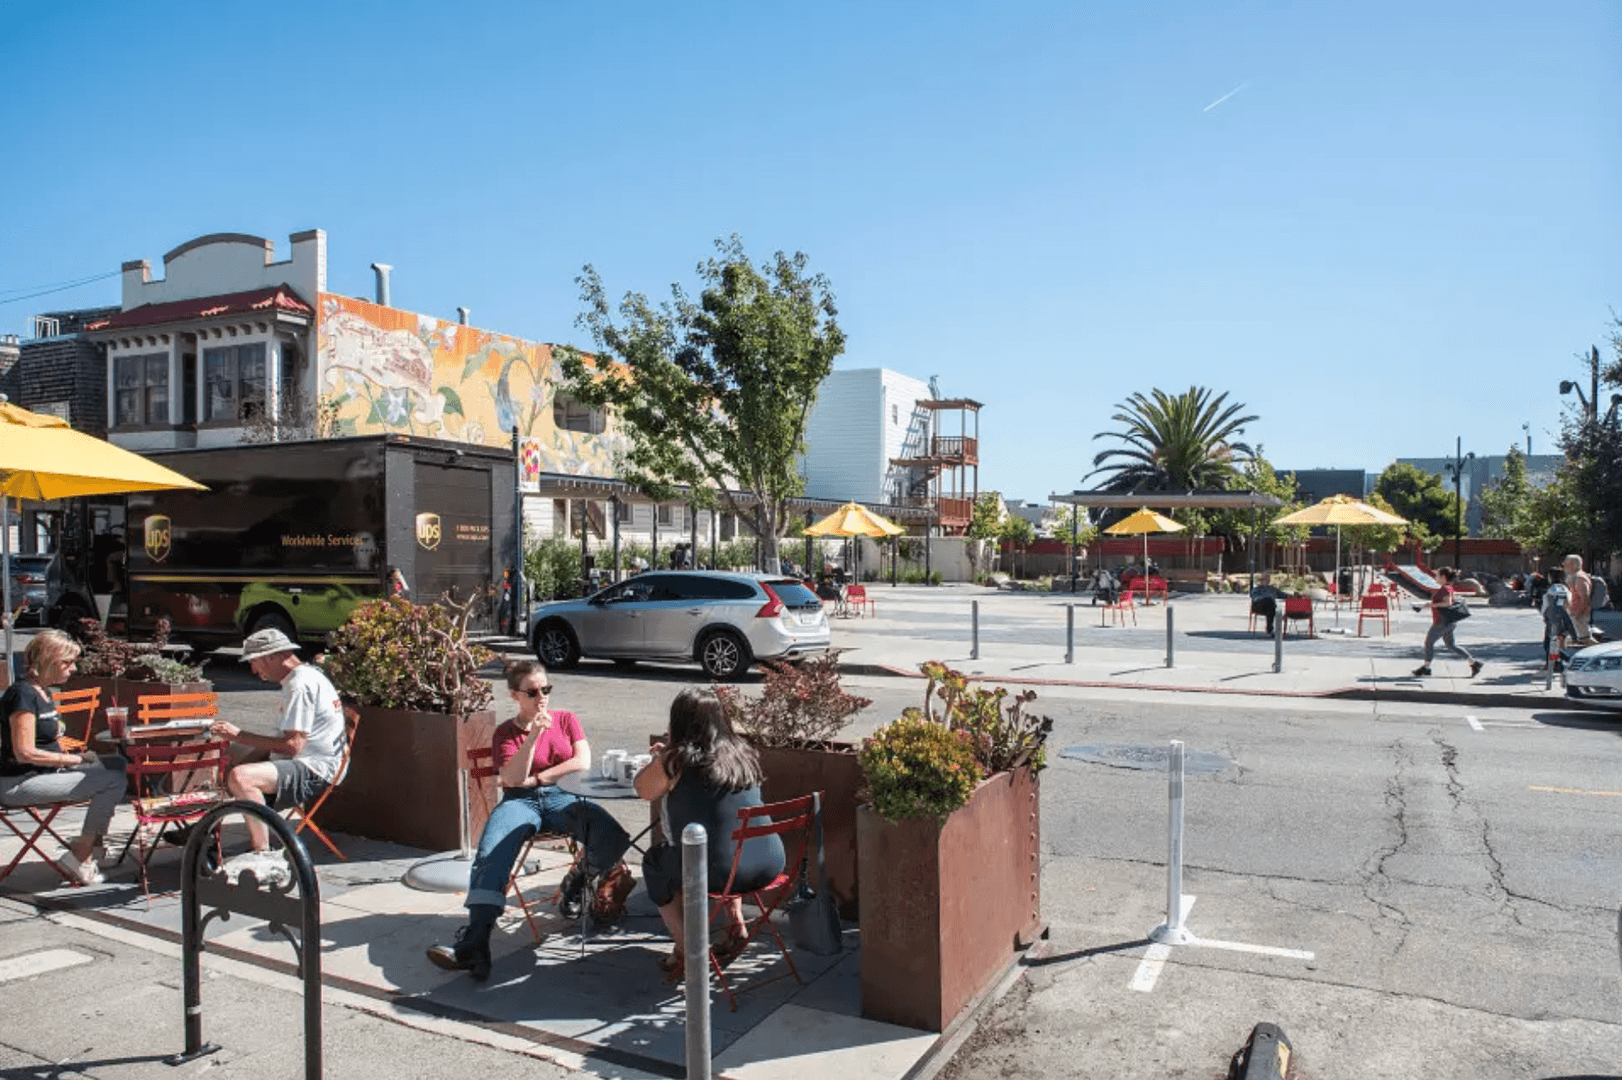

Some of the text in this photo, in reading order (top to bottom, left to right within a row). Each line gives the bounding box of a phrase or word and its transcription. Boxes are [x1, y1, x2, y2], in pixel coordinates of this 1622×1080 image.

[147, 530, 170, 555] ups
[281, 534, 364, 546] Worldwide Services
[419, 524, 440, 543] ups
